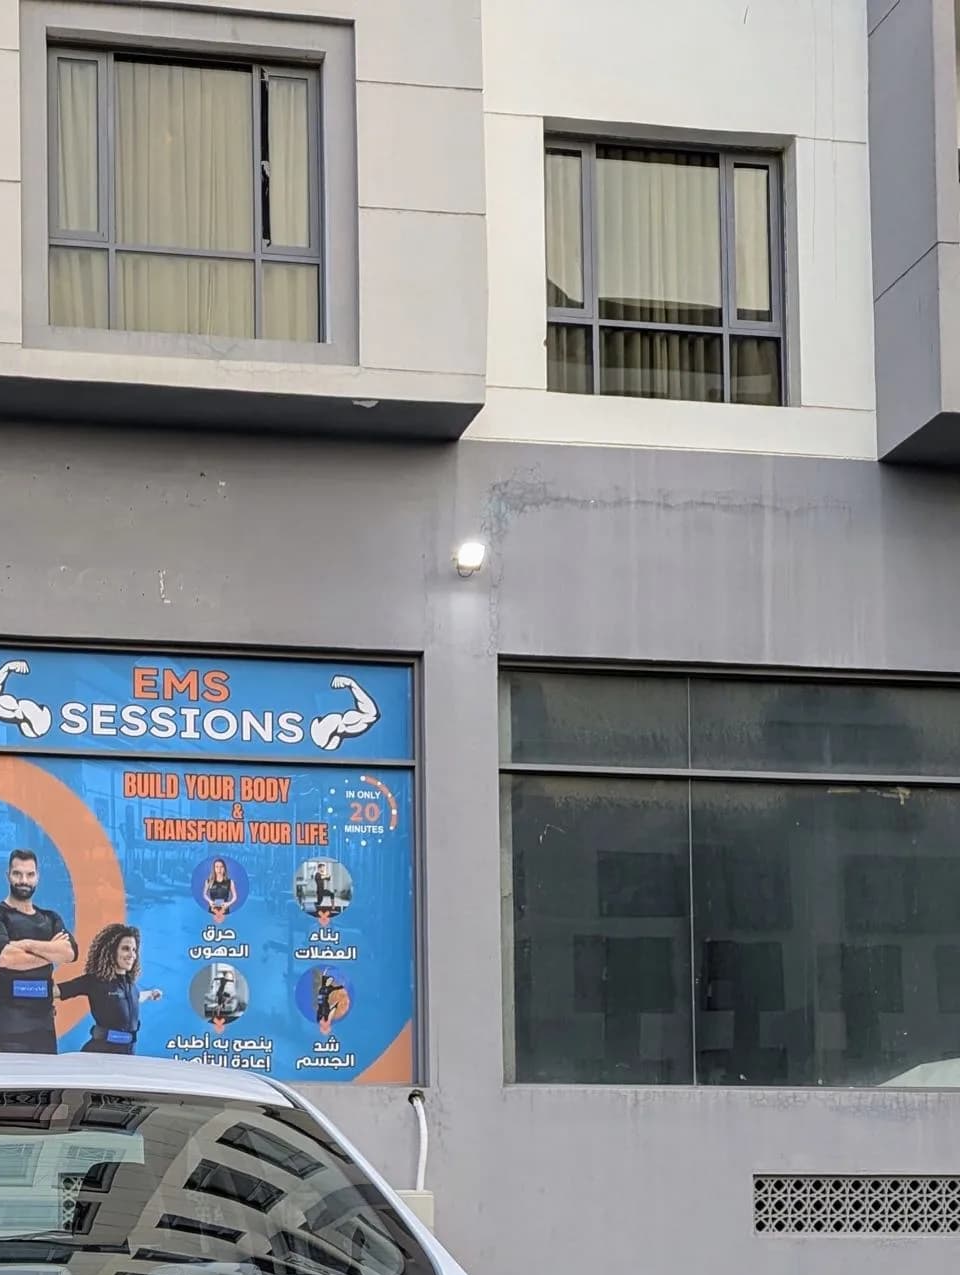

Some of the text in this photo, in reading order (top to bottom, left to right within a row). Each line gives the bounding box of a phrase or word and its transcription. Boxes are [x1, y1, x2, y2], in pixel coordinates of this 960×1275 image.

[132, 667, 231, 702] EMS
[59, 702, 305, 744] SESSIONS
[123, 771, 291, 804] BUILD YOUR BODY
[345, 790, 381, 800] IN ONLY
[231, 803, 244, 819] &
[349, 802, 380, 823] 20
[144, 818, 329, 847] TRANSFORM YOUR LIFE
[344, 824, 384, 834] MINUTES
[202, 926, 236, 941] حرق
[310, 928, 340, 944] بناء
[189, 945, 249, 959] الدهون
[295, 947, 357, 961] العضلات
[313, 1036, 340, 1053] شد
[296, 1054, 355, 1069] الجسم
